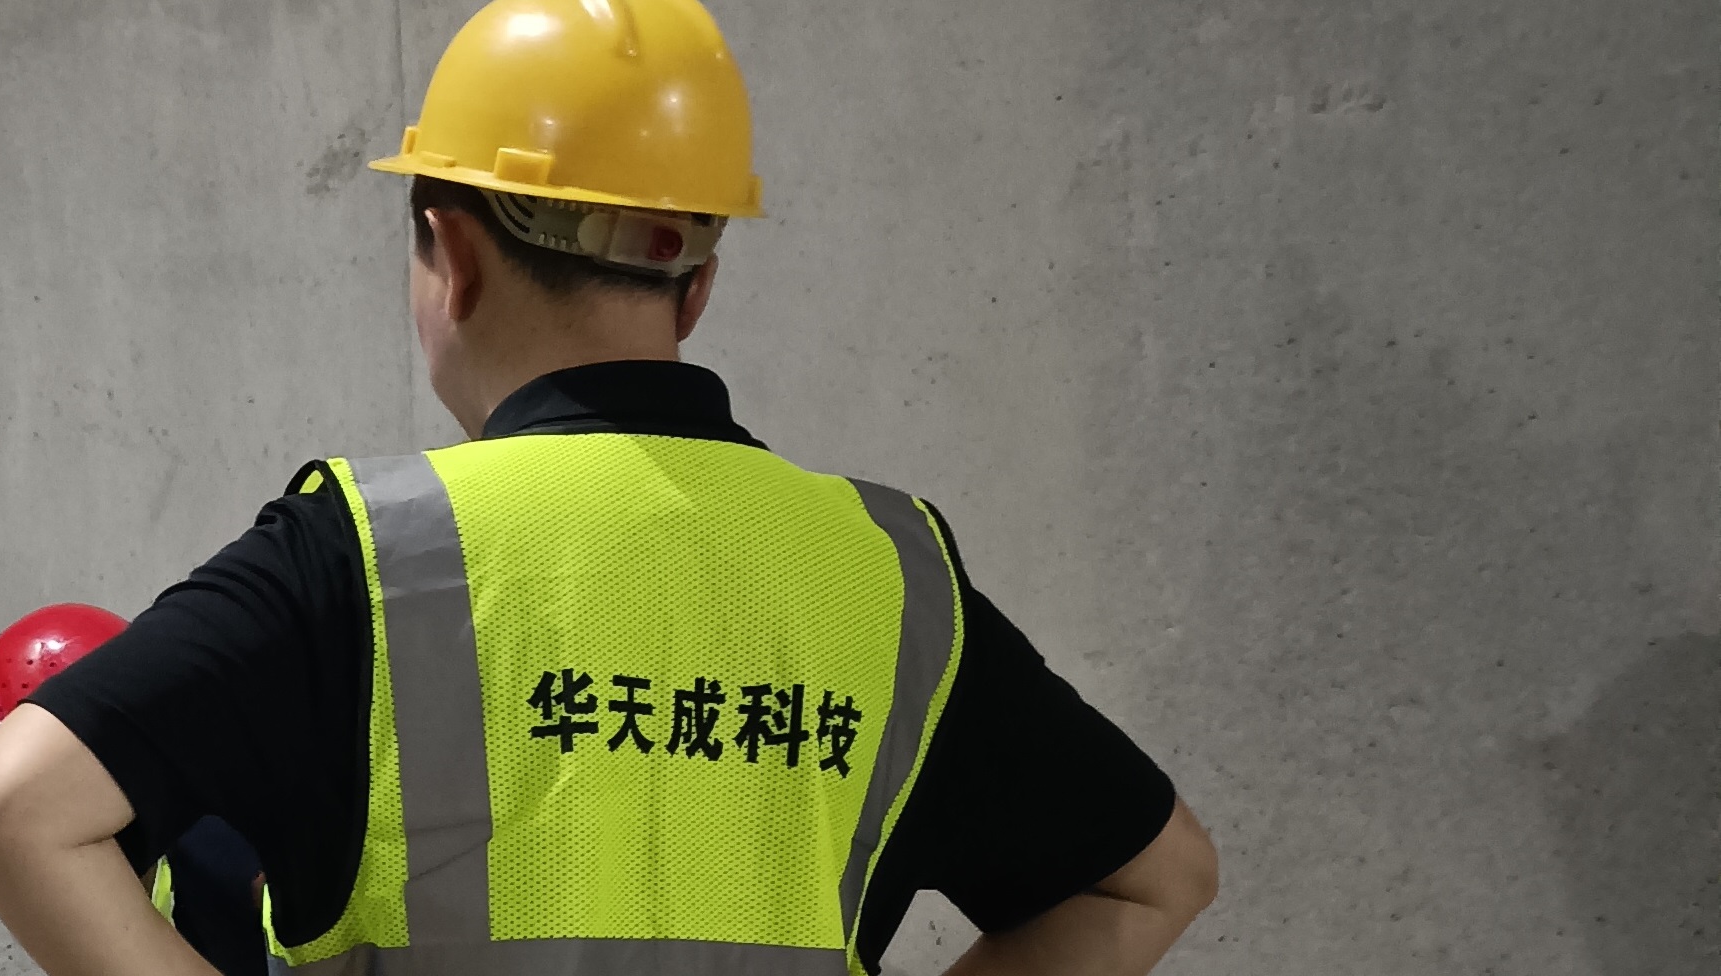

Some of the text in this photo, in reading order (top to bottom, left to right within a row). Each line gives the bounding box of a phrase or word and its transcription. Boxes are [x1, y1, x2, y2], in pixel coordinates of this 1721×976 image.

[526, 667, 864, 779] 华天成科技
